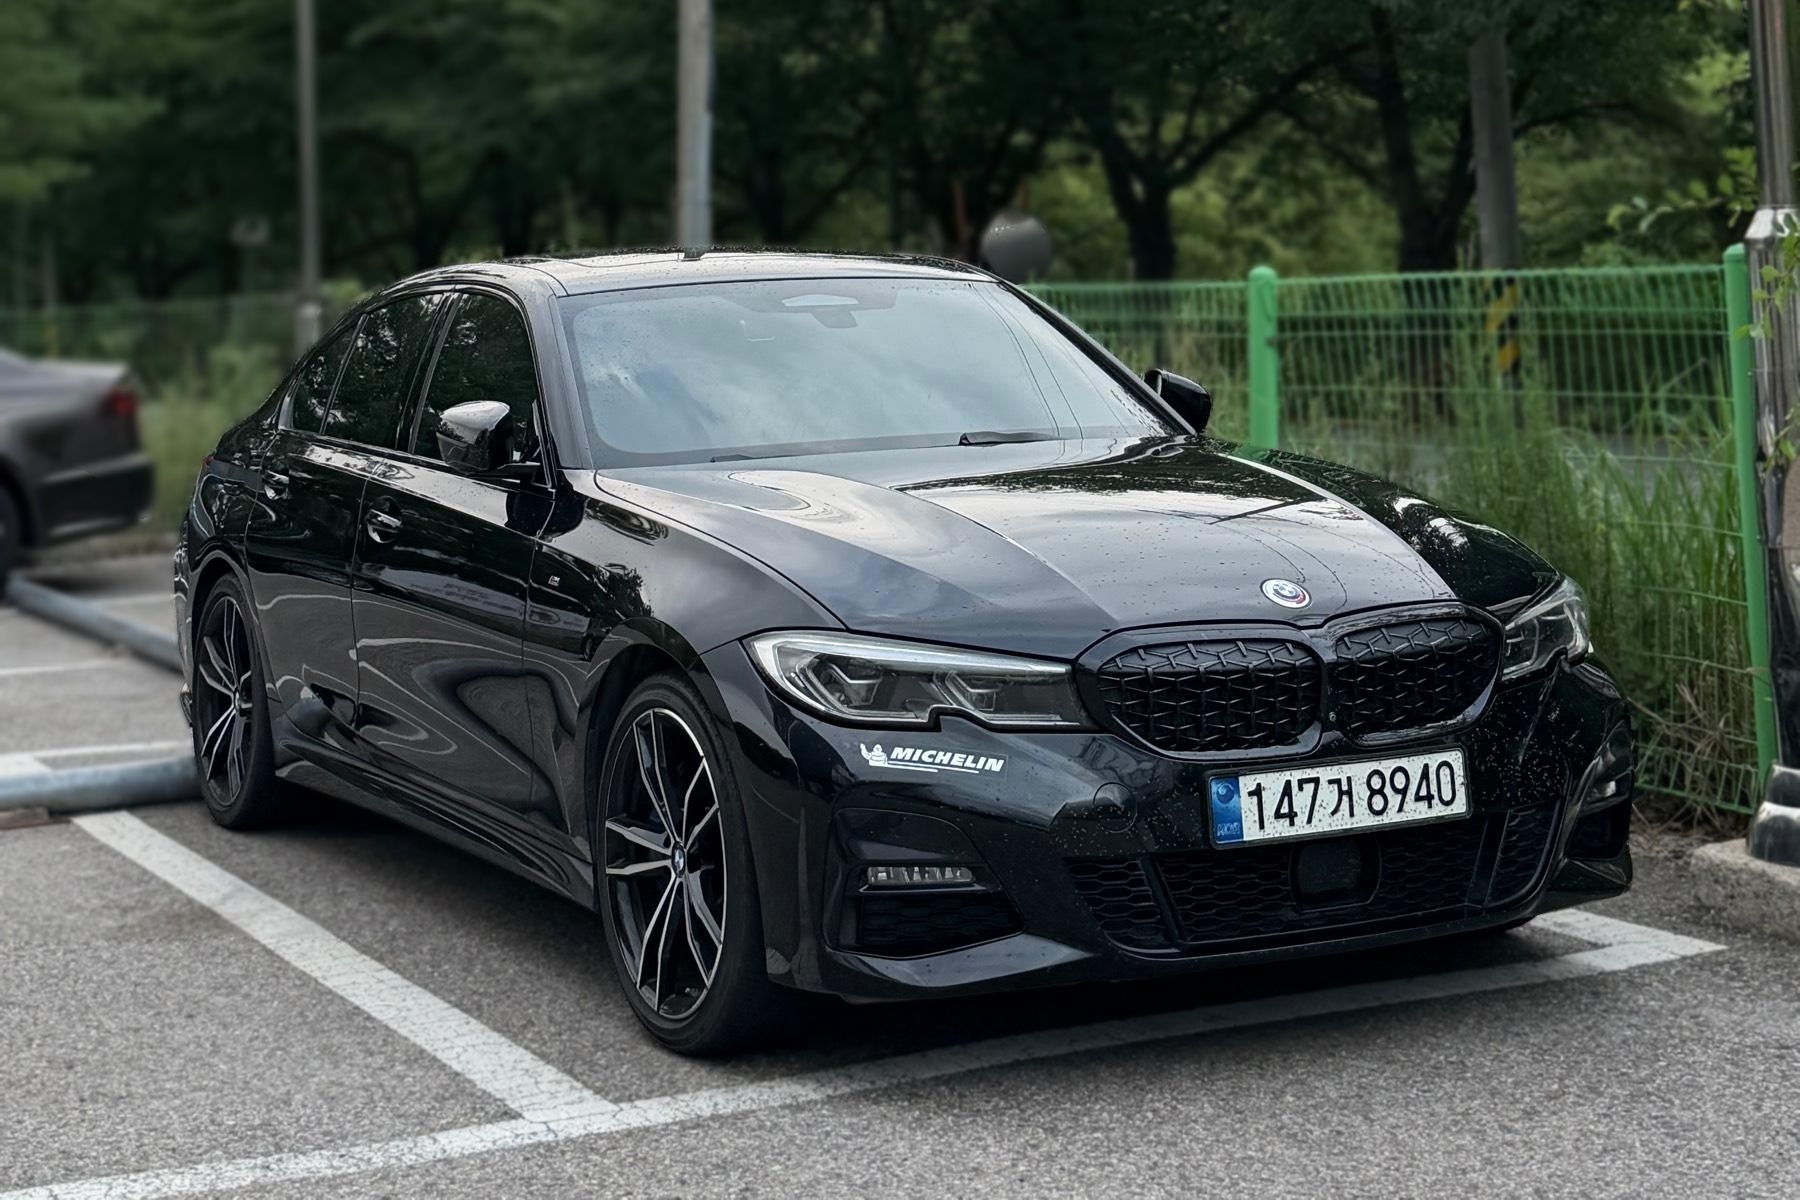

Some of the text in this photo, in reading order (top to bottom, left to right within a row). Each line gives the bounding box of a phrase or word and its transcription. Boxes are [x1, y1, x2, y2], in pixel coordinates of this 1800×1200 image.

[890, 747, 1004, 772] MICHELIN
[1247, 760, 1457, 830] 147거 8940
